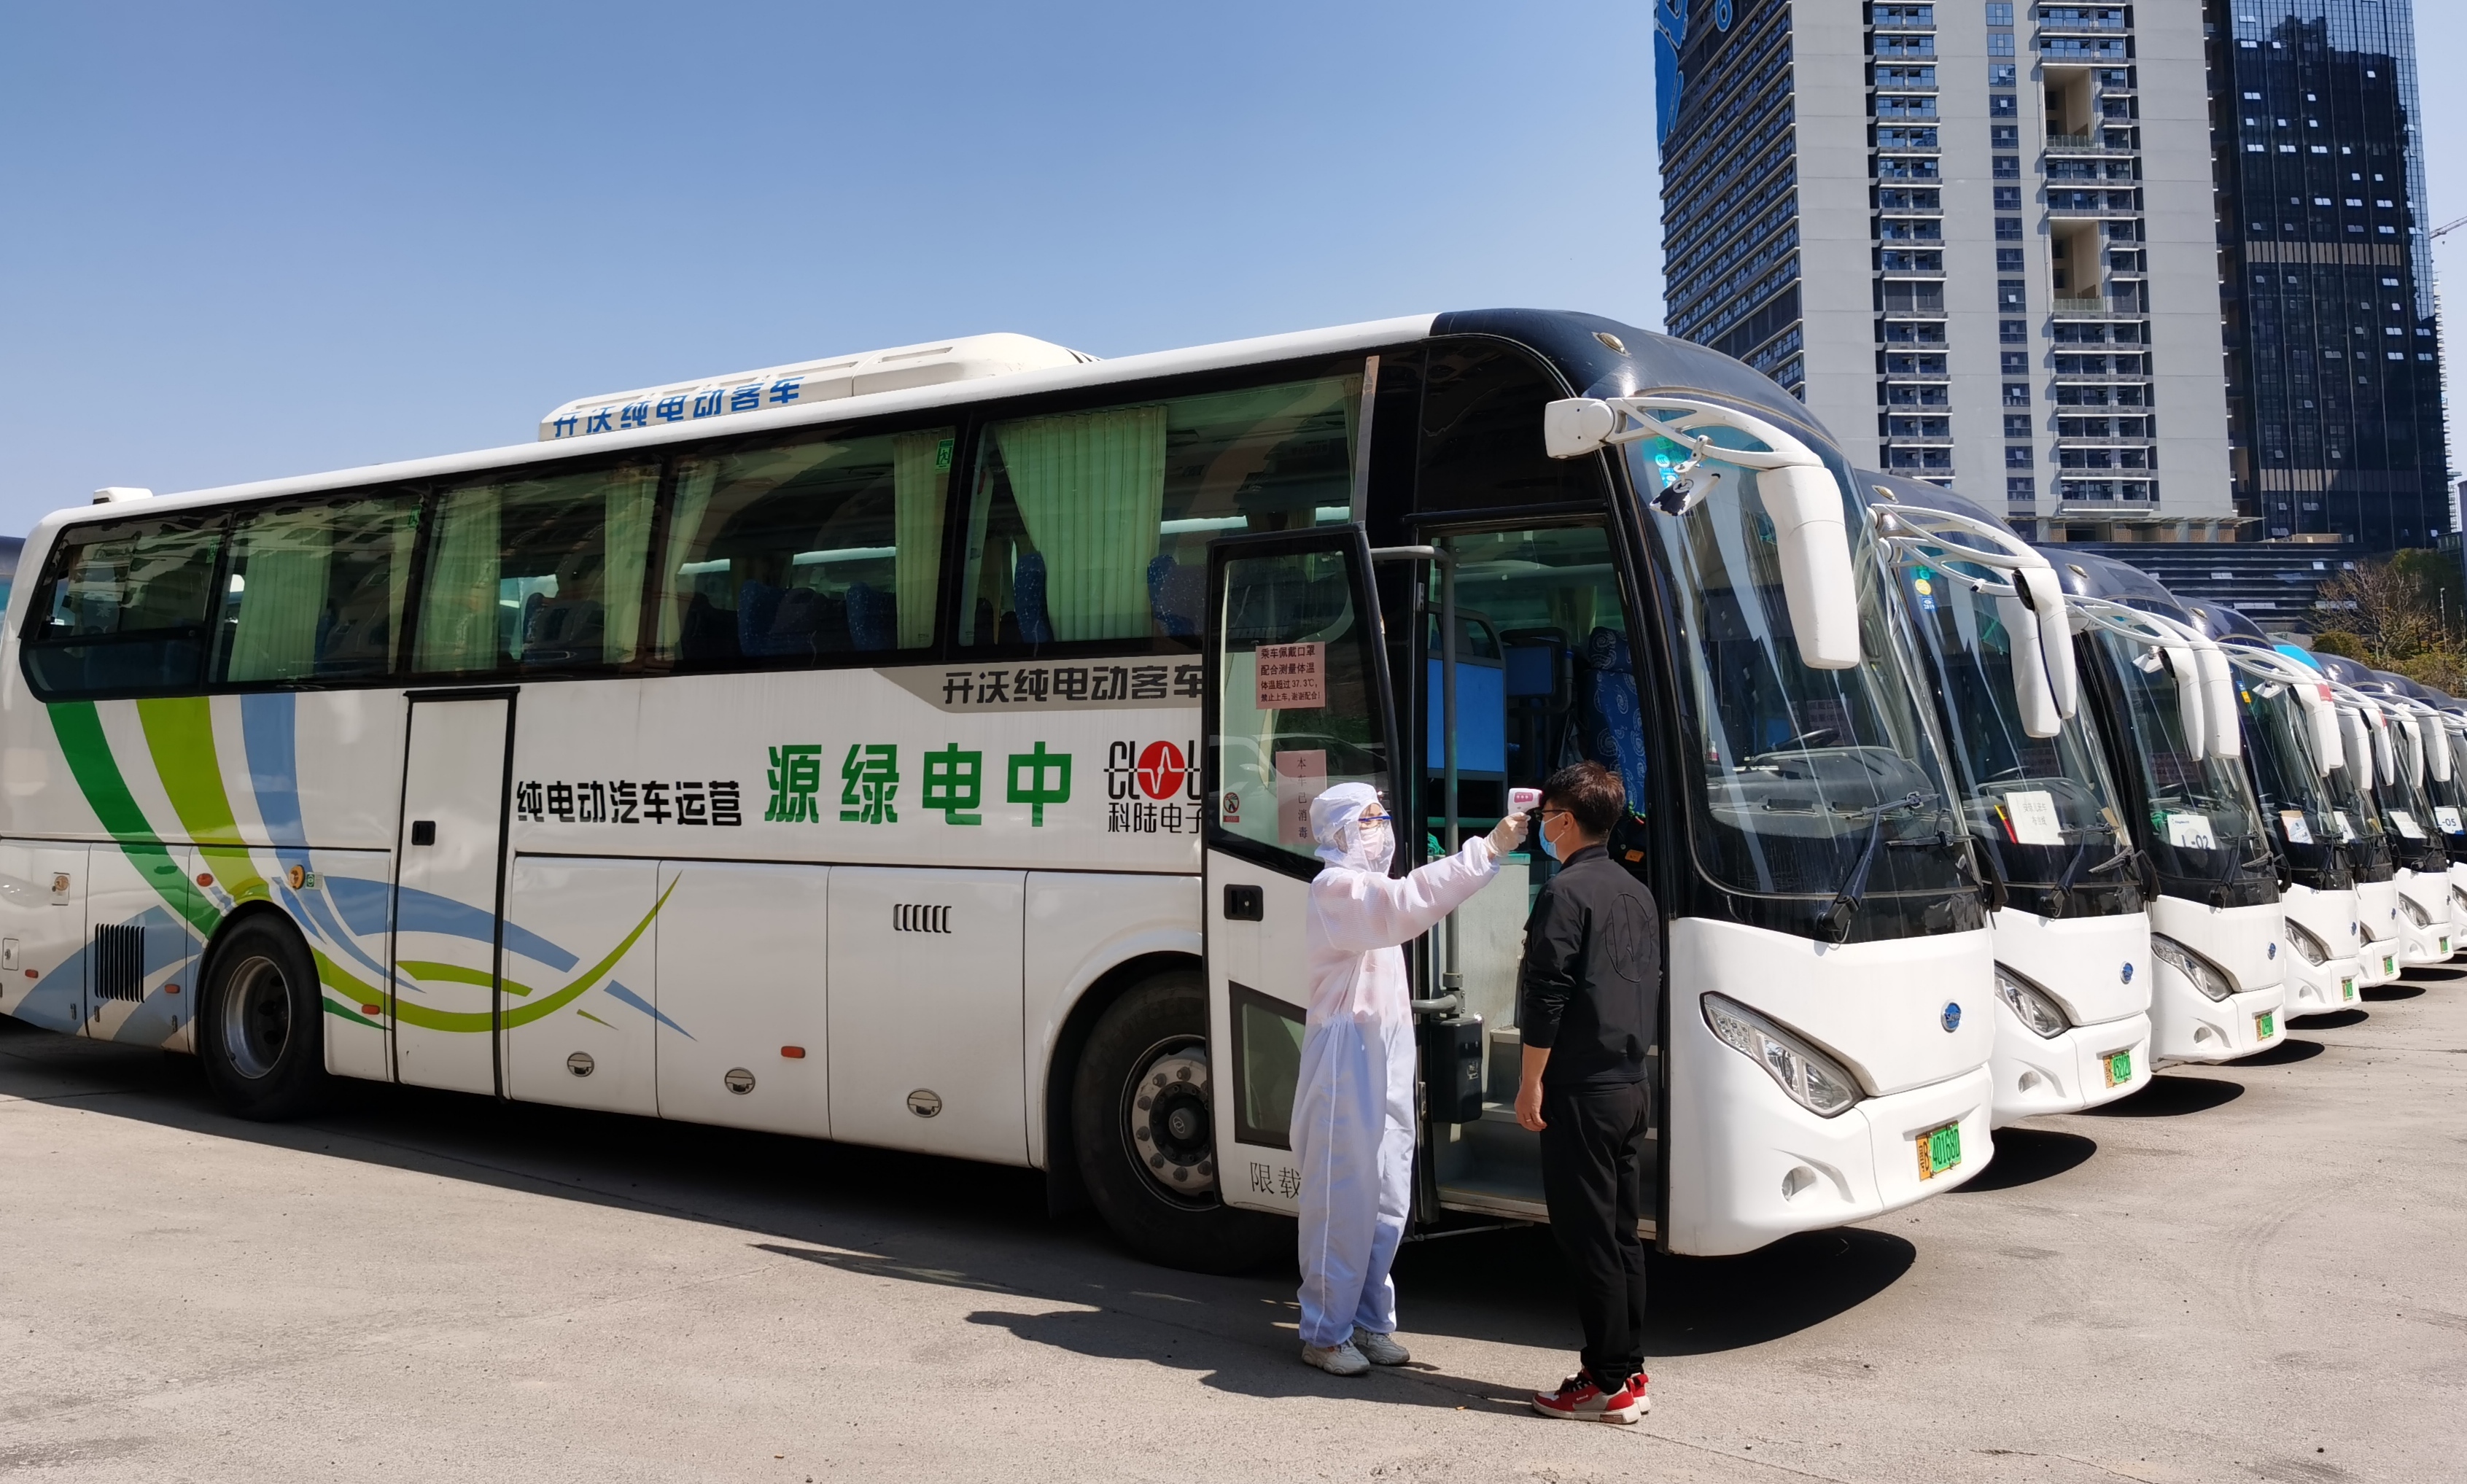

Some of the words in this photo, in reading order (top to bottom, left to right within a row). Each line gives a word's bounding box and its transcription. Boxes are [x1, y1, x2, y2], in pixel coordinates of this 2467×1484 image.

[553, 376, 805, 438] 开沃纯电动客车
[1260, 662, 1315, 676] 配合测量体温
[1261, 645, 1316, 659] 乘车佩戴口罩
[943, 664, 1203, 704] 开沃纯电动客车
[516, 780, 742, 826] 纯电动汽车运营
[1108, 802, 1202, 834] 科陆电子
[1250, 1162, 1301, 1200] 限载
